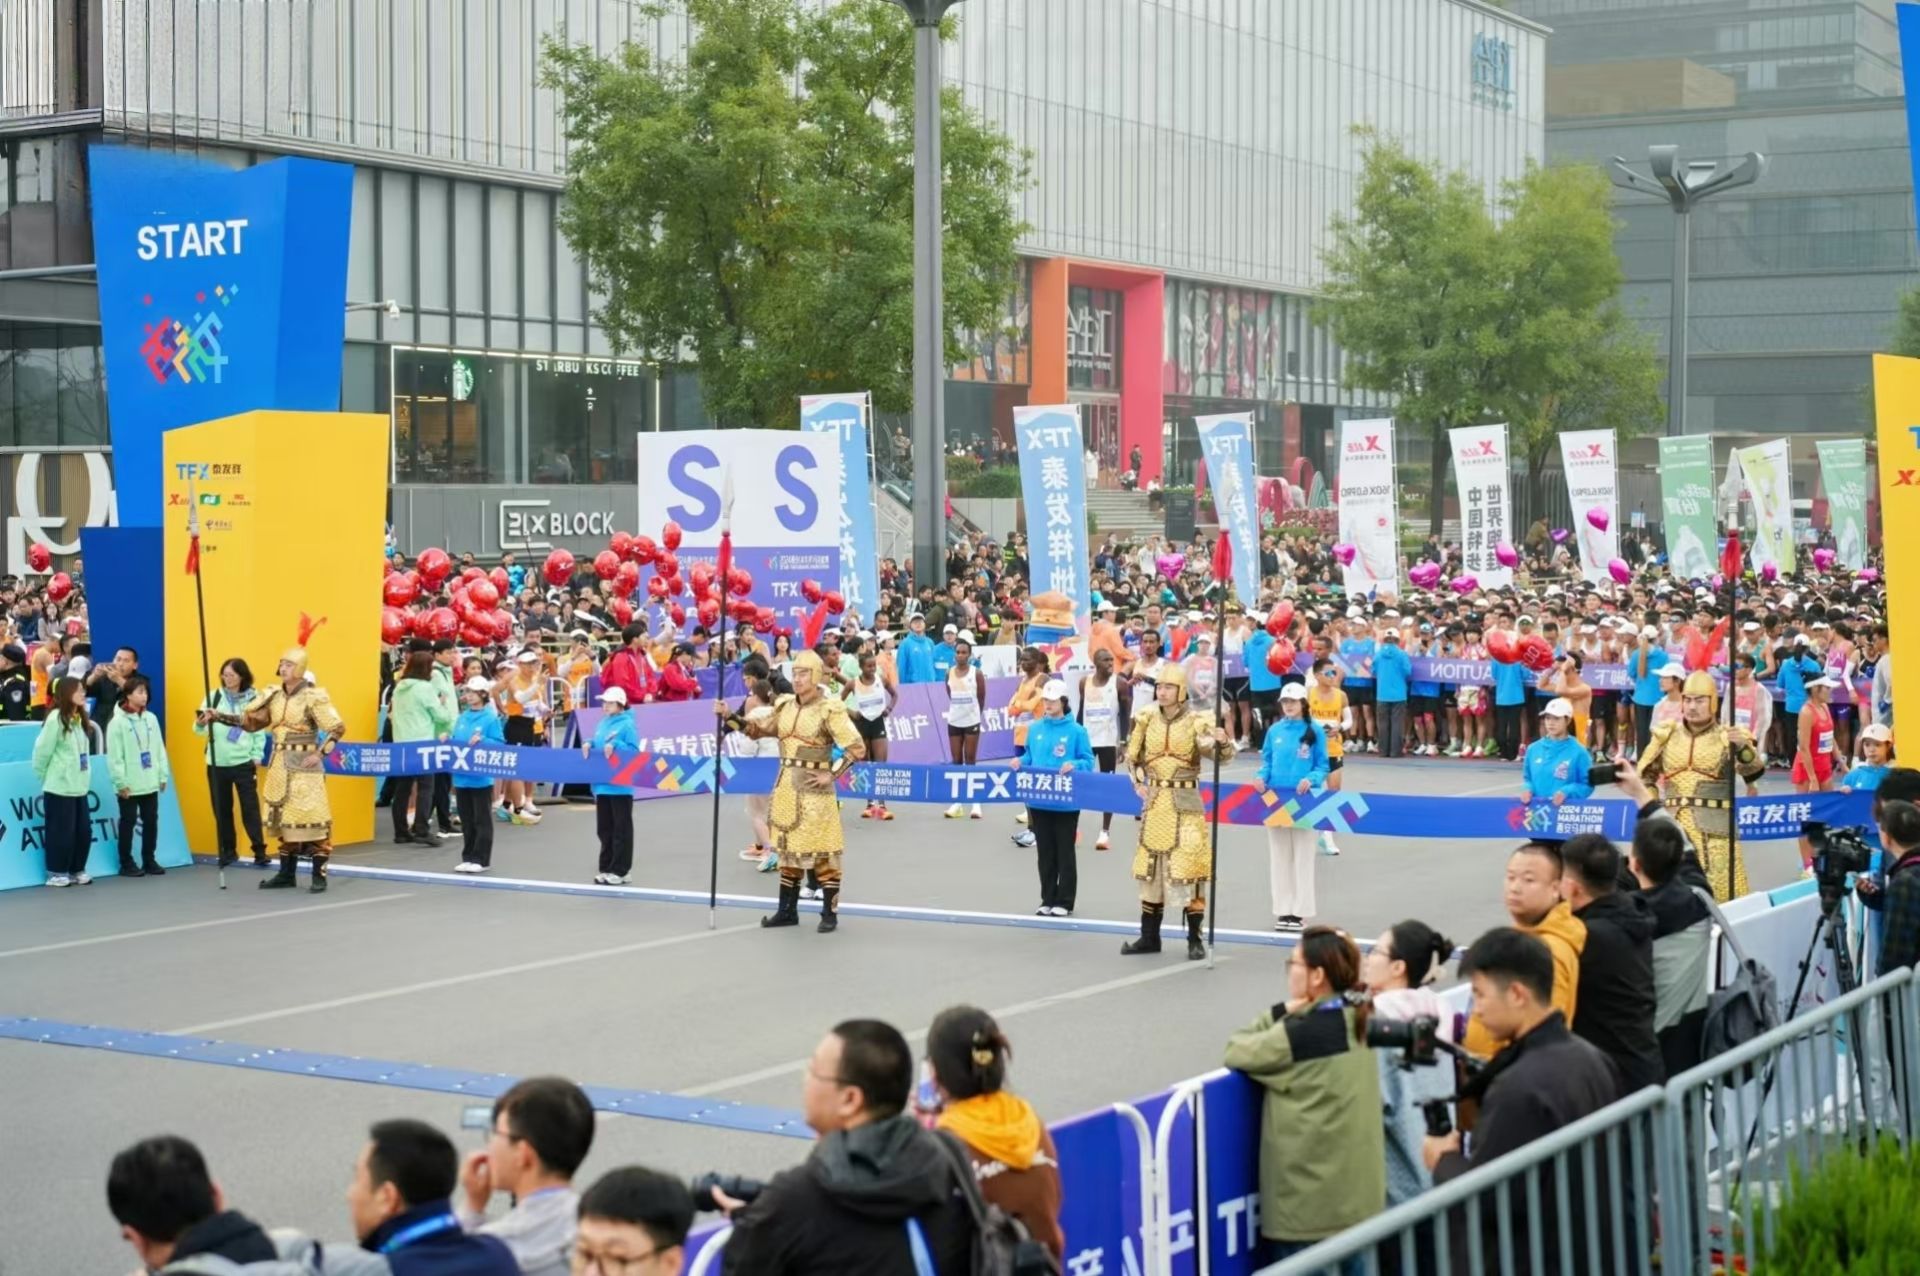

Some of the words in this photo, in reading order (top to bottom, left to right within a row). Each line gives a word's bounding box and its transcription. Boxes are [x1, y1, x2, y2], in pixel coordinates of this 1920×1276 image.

[137, 219, 248, 261] START
[536, 359, 599, 375] STRBUKS
[667, 444, 721, 533] S
[775, 444, 819, 533] S
[550, 511, 615, 536] BLOCK
[417, 744, 472, 771] TFX
[875, 768, 892, 777] 2024
[875, 777, 912, 786] MARATHON
[944, 771, 1011, 799] TFX
[1015, 772, 1073, 793] 泰发祥
[10, 790, 101, 822] WOD
[1557, 814, 1604, 823] MARATHON
[1738, 801, 1812, 825] 泰发祥
